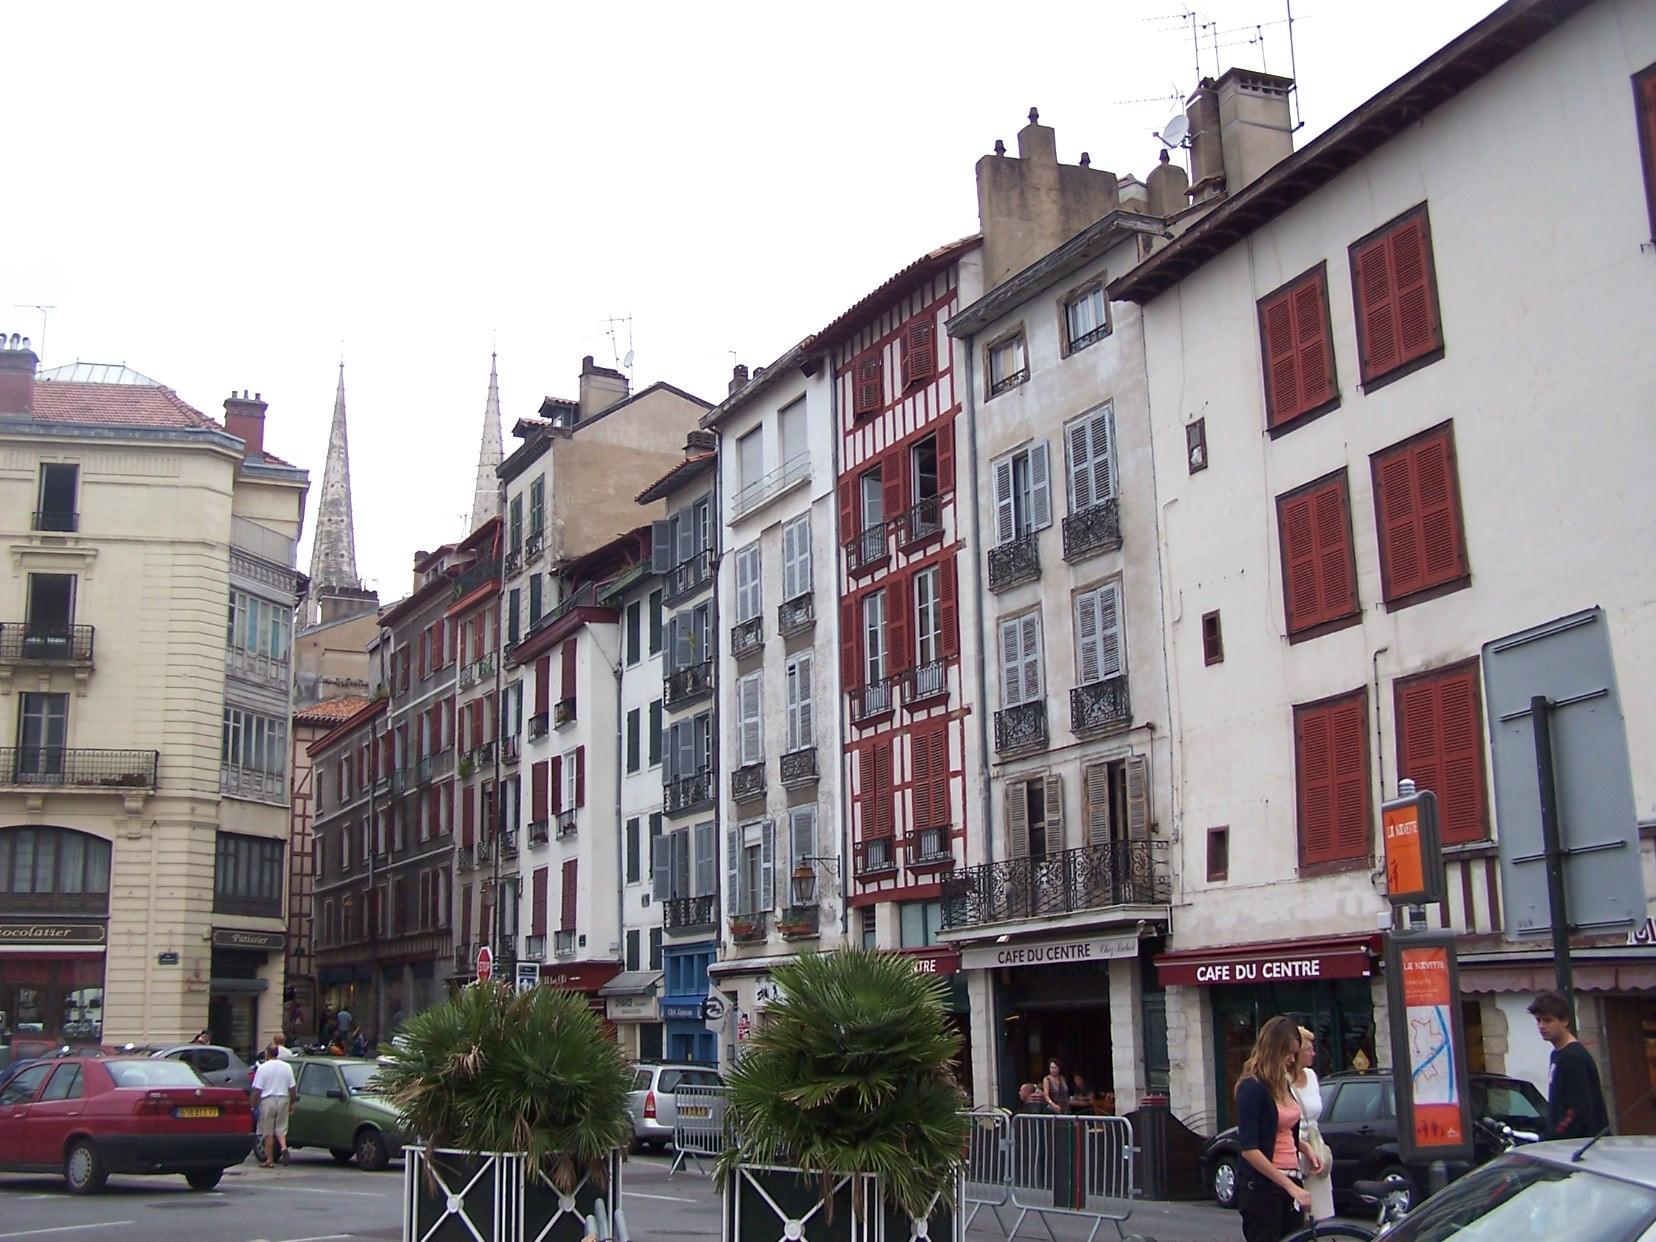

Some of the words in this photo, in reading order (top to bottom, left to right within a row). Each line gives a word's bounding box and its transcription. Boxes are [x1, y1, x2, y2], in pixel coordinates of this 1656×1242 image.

[997, 951, 1024, 964] CAFE
[1027, 948, 1043, 962] DU
[1046, 943, 1091, 960] CENTRE
[479, 961, 491, 972] STOP
[1196, 965, 1230, 981] CAFE
[1235, 963, 1257, 980] DU
[1262, 959, 1320, 978] CENTRE
